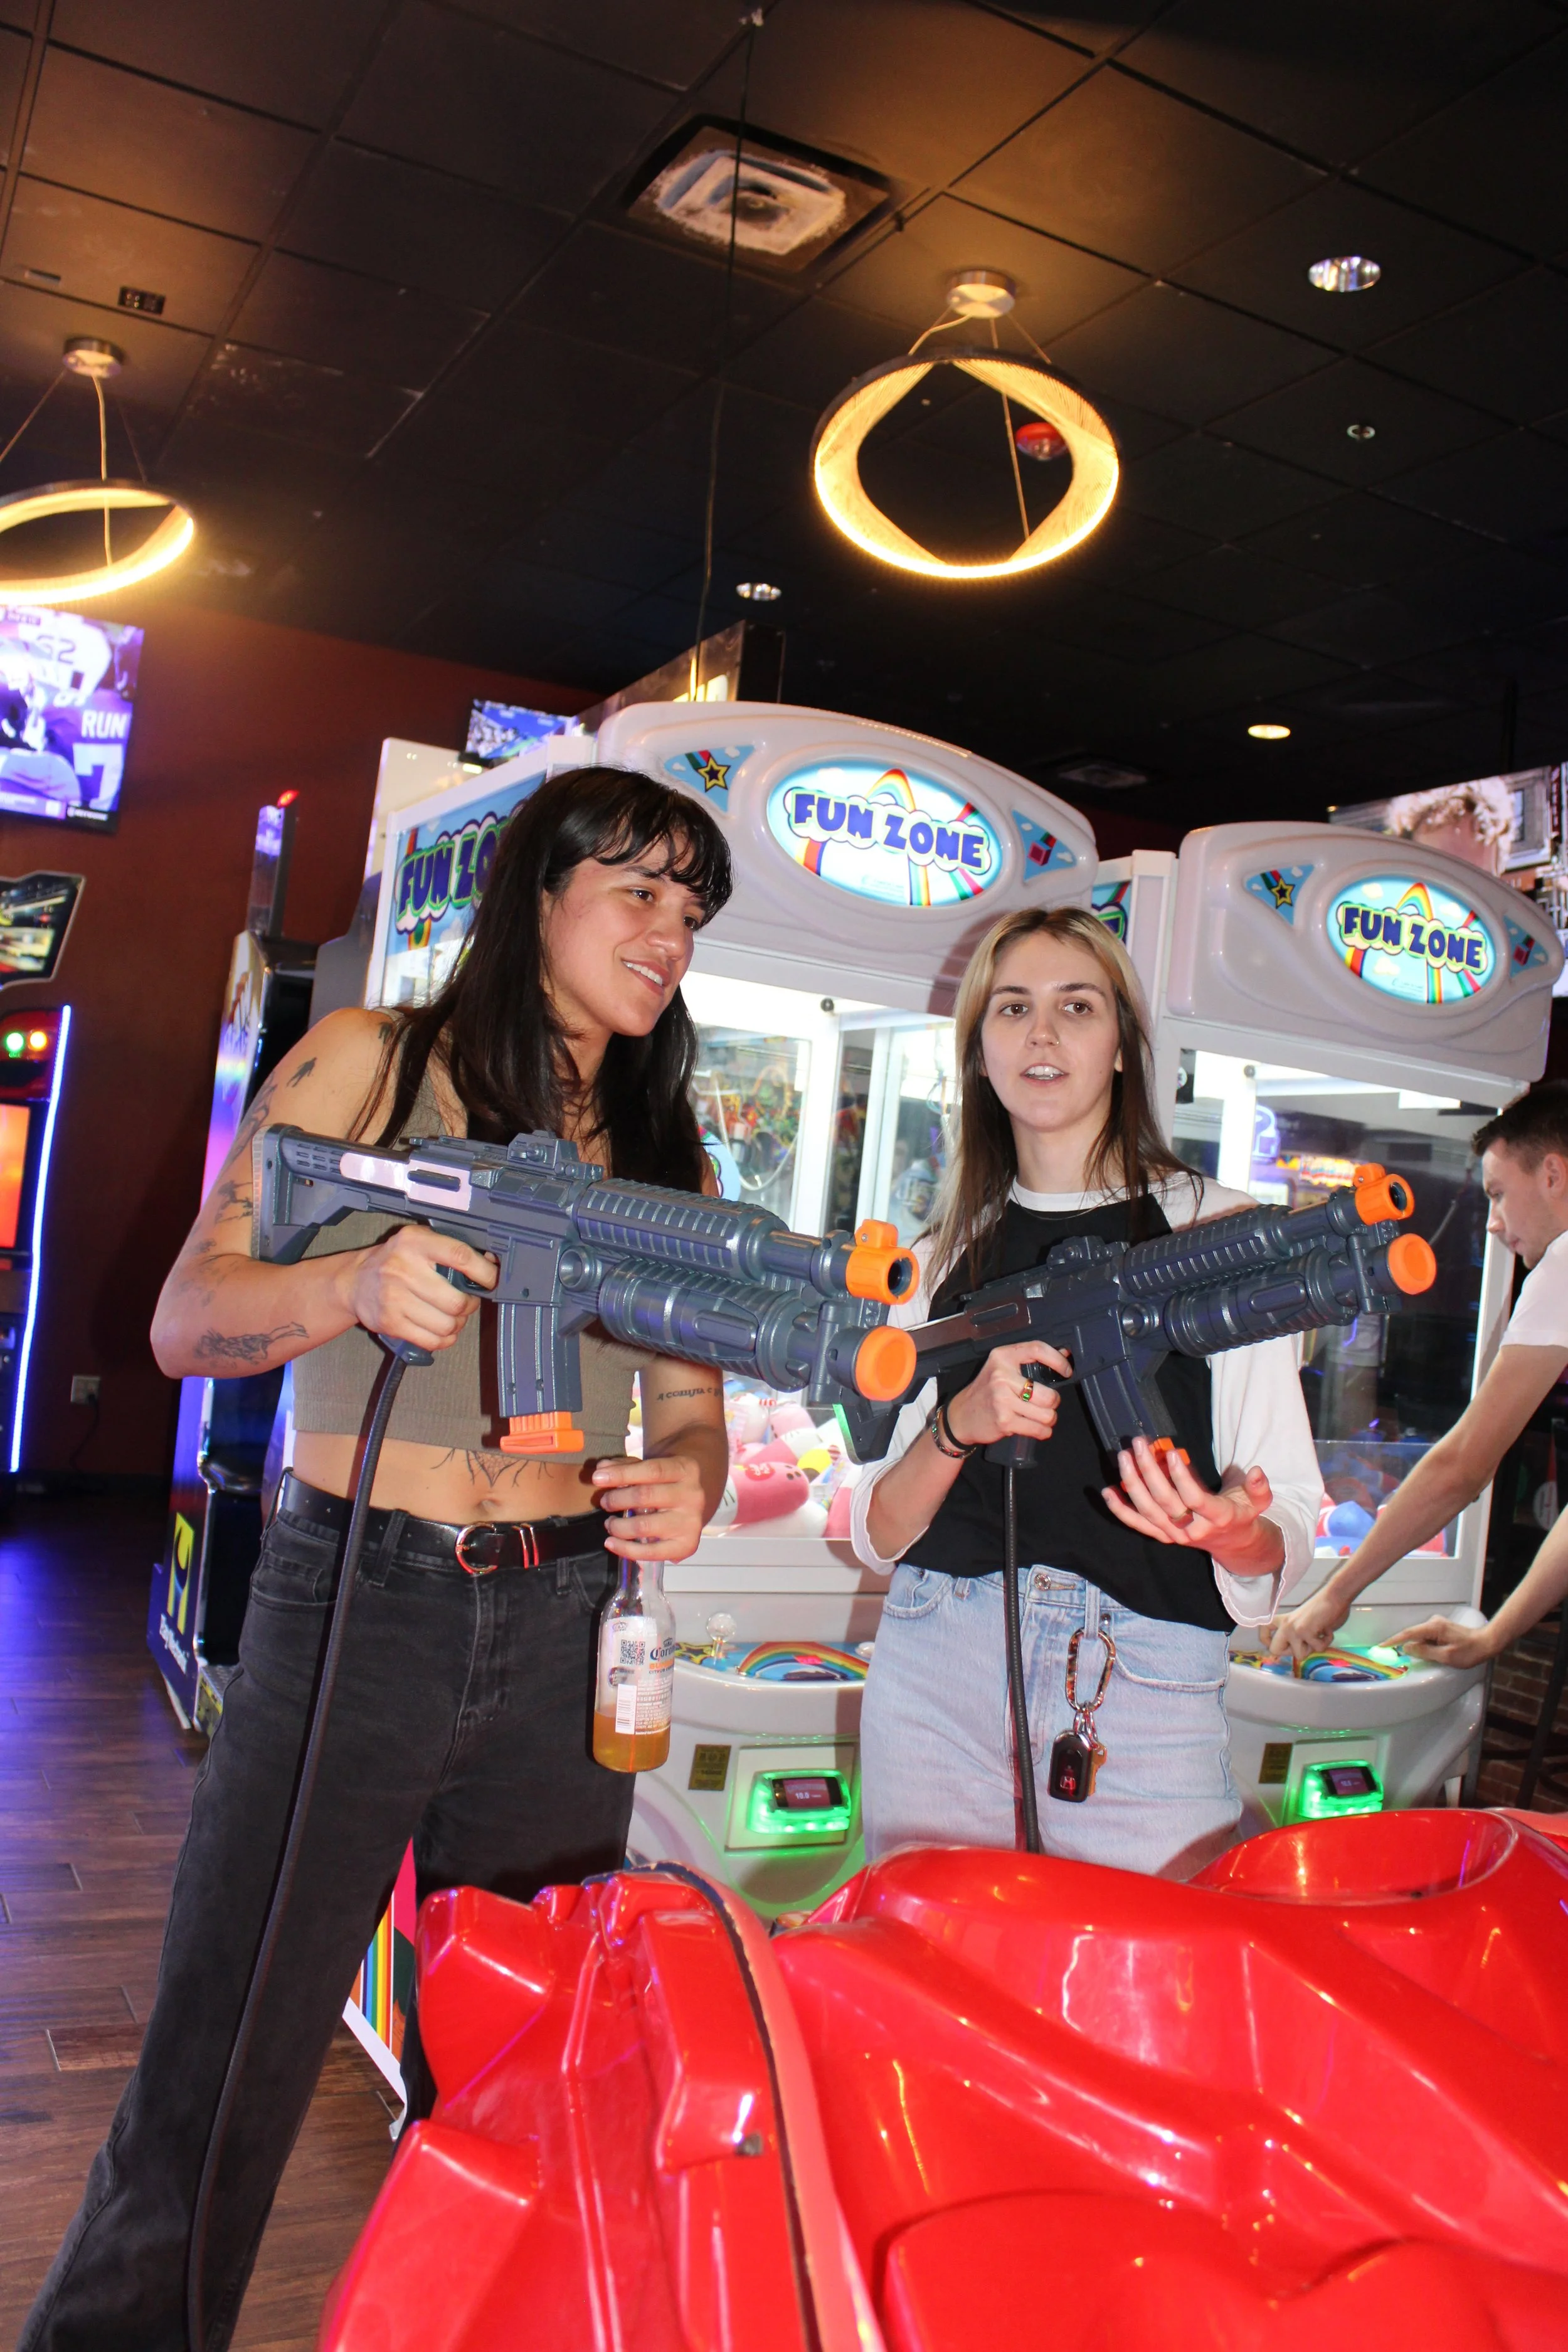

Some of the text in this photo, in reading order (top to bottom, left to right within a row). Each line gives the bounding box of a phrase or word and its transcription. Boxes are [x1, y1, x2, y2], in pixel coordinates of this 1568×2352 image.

[81, 709, 128, 739] RUN
[794, 793, 984, 869] FUN ZONE
[398, 831, 499, 915] FUN ZO
[1344, 907, 1483, 969] FUN ZONE
